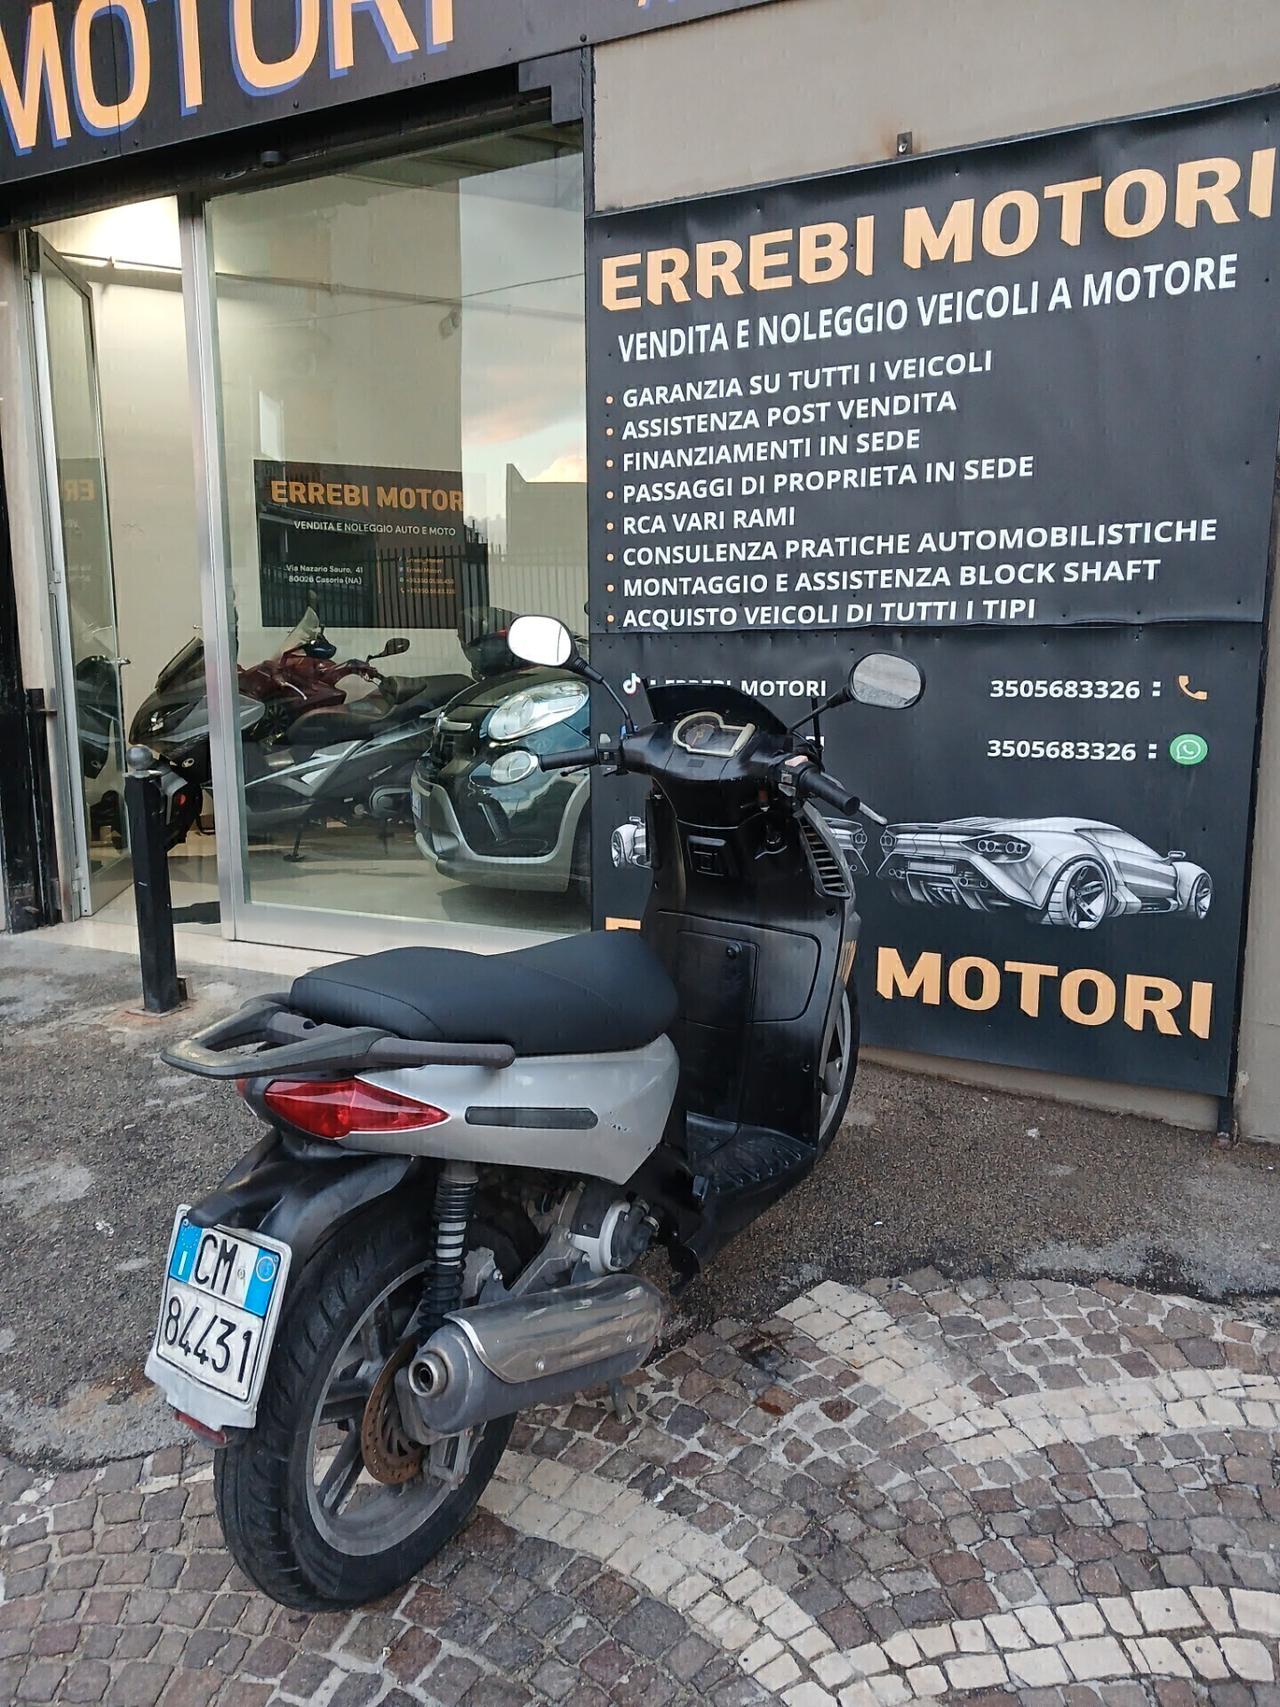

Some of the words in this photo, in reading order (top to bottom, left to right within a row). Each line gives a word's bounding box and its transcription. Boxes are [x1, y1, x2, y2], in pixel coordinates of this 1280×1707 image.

[602, 214, 876, 311] ERREBI
[903, 147, 1277, 272] MOTORI
[617, 322, 730, 363] VENDITA
[736, 318, 750, 349] E
[758, 298, 908, 346] NOLEGGIO
[916, 280, 1039, 327] VEICOLI
[1047, 277, 1072, 312] A
[1082, 253, 1238, 307] MOTORE
[622, 377, 744, 408] GARANZIA
[749, 372, 781, 396] SU
[788, 364, 860, 391] TUTTI
[869, 362, 876, 383] I
[883, 349, 992, 381] VEICOLI
[621, 409, 761, 441] ASSISTENZA
[767, 401, 832, 427] POST
[837, 390, 957, 420] VENDITA
[623, 437, 811, 472] FINANZIAMENTI
[820, 434, 848, 457] IN
[856, 428, 921, 454] SEDE
[271, 480, 369, 508] ERREBI
[376, 486, 464, 511] MOTOR
[623, 477, 733, 504] PASSAGGI
[741, 475, 765, 496] DI
[773, 464, 918, 493] PROPRIETA
[925, 460, 955, 483] IN
[963, 455, 1034, 481] SEDE
[294, 520, 334, 531] VENDITA
[337, 521, 342, 531] E
[344, 522, 393, 533] NOLEGGIO
[395, 525, 420, 535] AUTO
[422, 525, 428, 535] E
[429, 526, 456, 536] MOTO
[623, 514, 667, 535] RCA
[671, 510, 725, 532] VARI
[733, 506, 795, 529] RAMI
[623, 541, 778, 566] CONSULENZA
[785, 533, 910, 559] PRATICHE
[916, 518, 1217, 553] AUTOMOBILISTICHE
[286, 564, 298, 572] Via
[300, 564, 328, 573] Nazario
[624, 574, 768, 597] MONTAGGIO
[776, 573, 788, 593] E
[794, 566, 951, 592] ASSISTENZA
[959, 562, 1056, 586] BLOCK
[1063, 559, 1162, 583] SHAFT
[622, 607, 738, 631] ACQUISTO
[743, 604, 838, 625] VEICOLI
[846, 603, 873, 623] DI
[880, 600, 957, 622] TUTTI
[966, 600, 974, 621] I
[982, 598, 1035, 620] TIPI
[741, 680, 826, 697] MOTORI
[990, 679, 1140, 699] 3505683326
[987, 739, 1137, 761] 3505683326
[876, 947, 1213, 1039] MOTORI
[193, 1233, 239, 1296] CM
[164, 1295, 253, 1384] 84431
